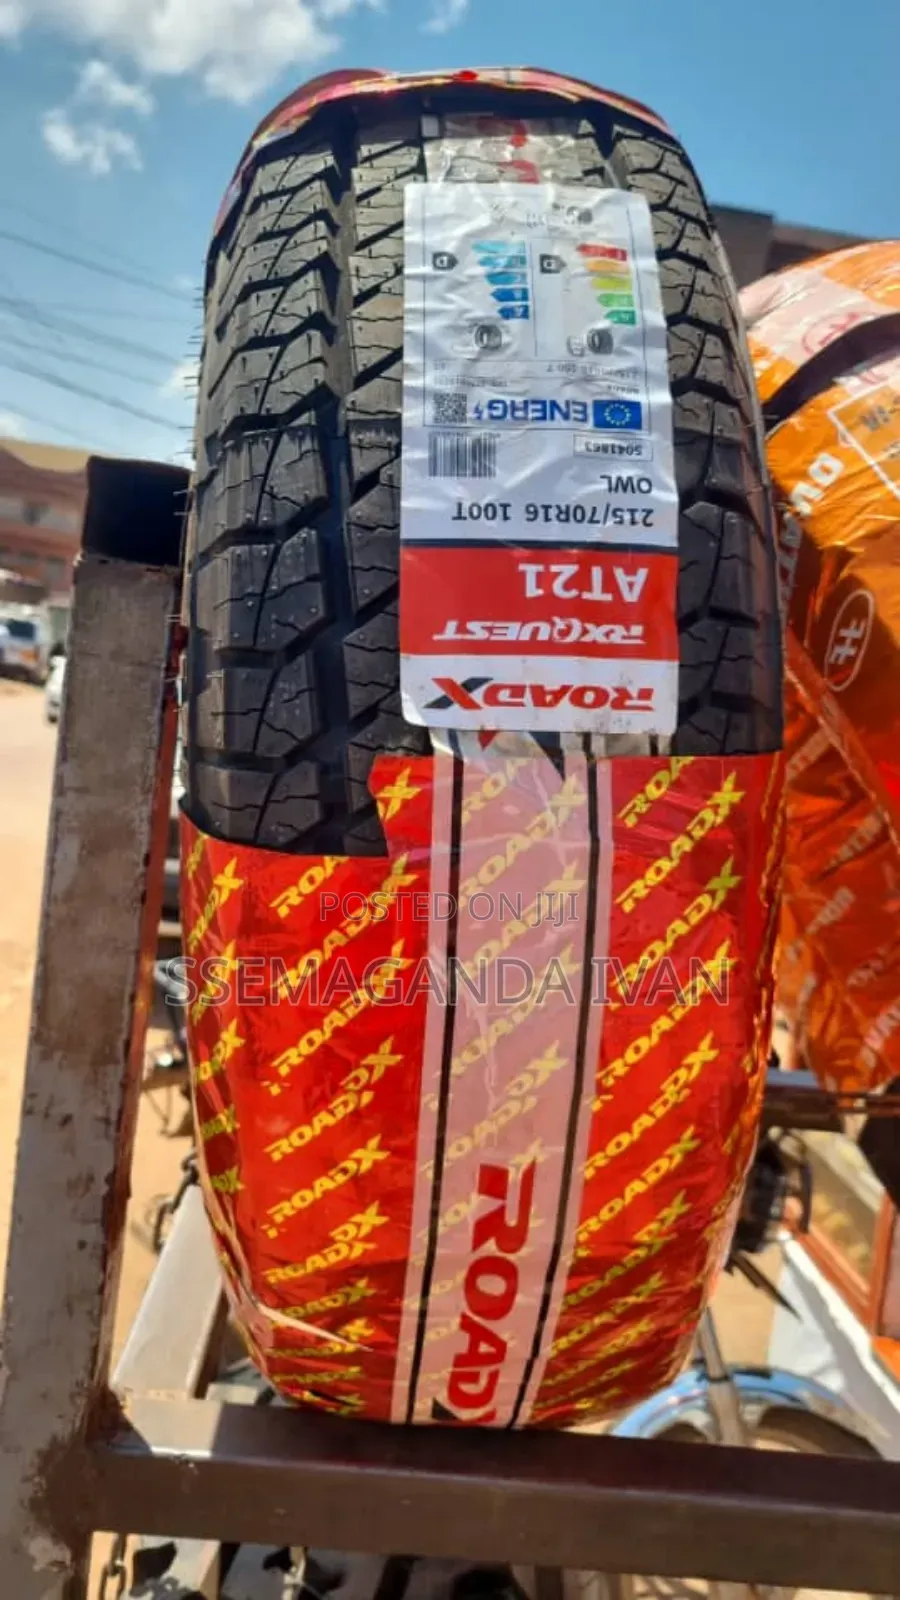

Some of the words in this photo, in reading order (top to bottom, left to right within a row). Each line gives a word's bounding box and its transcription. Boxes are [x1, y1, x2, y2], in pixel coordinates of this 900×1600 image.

[486, 398, 589, 424] ENERG
[451, 502, 512, 522] 100T
[525, 503, 654, 528] 215/70R16
[600, 475, 652, 494] OWL
[518, 563, 648, 602] AT21
[423, 676, 655, 712] ROADX
[457, 772, 588, 908] ROADX
[615, 770, 745, 912] ROADX
[272, 852, 419, 999] ROADX
[608, 856, 744, 997] ROADX
[270, 938, 415, 1077] ROADX
[595, 937, 739, 1088] ROADX
[267, 1133, 391, 1224] ROADX
[576, 1125, 700, 1242] ROADX
